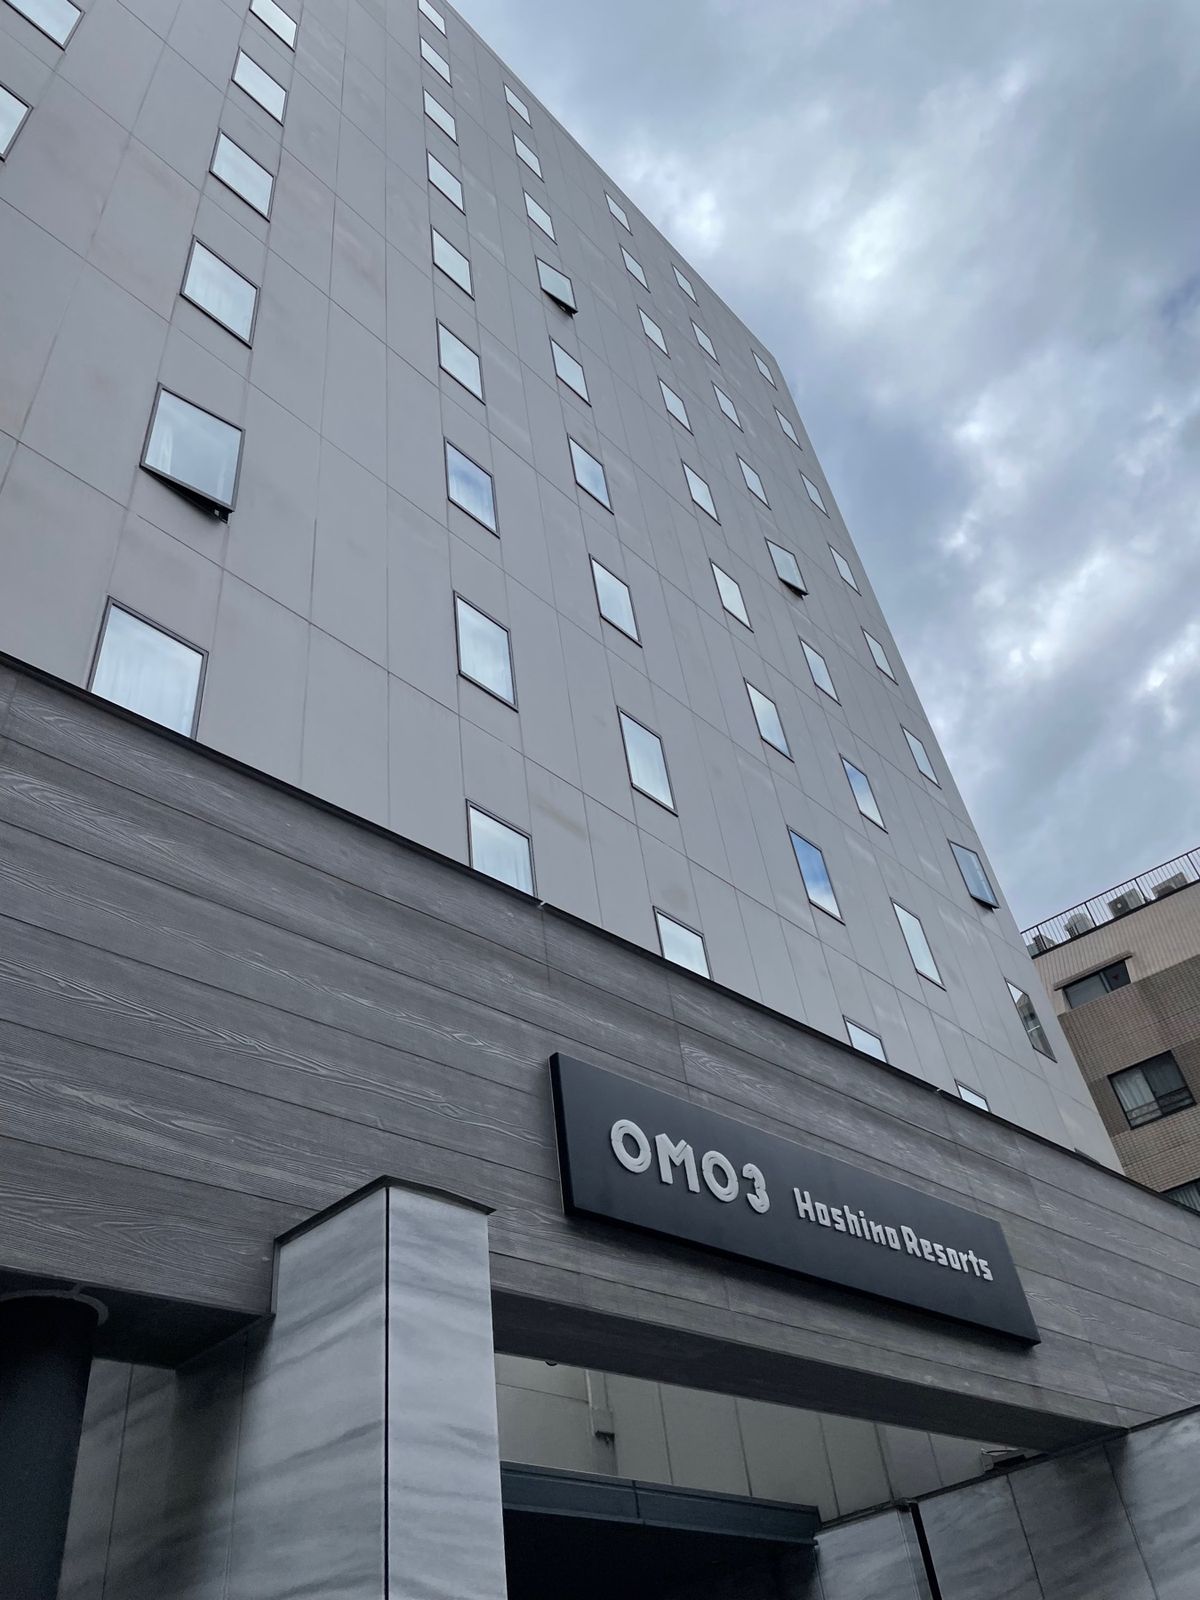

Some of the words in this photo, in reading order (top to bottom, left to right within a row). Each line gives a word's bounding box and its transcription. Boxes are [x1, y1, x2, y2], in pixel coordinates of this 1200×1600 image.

[610, 1119, 770, 1214] OMO3
[794, 1187, 901, 1251] Hoshino
[900, 1225, 994, 1281] Resorts
